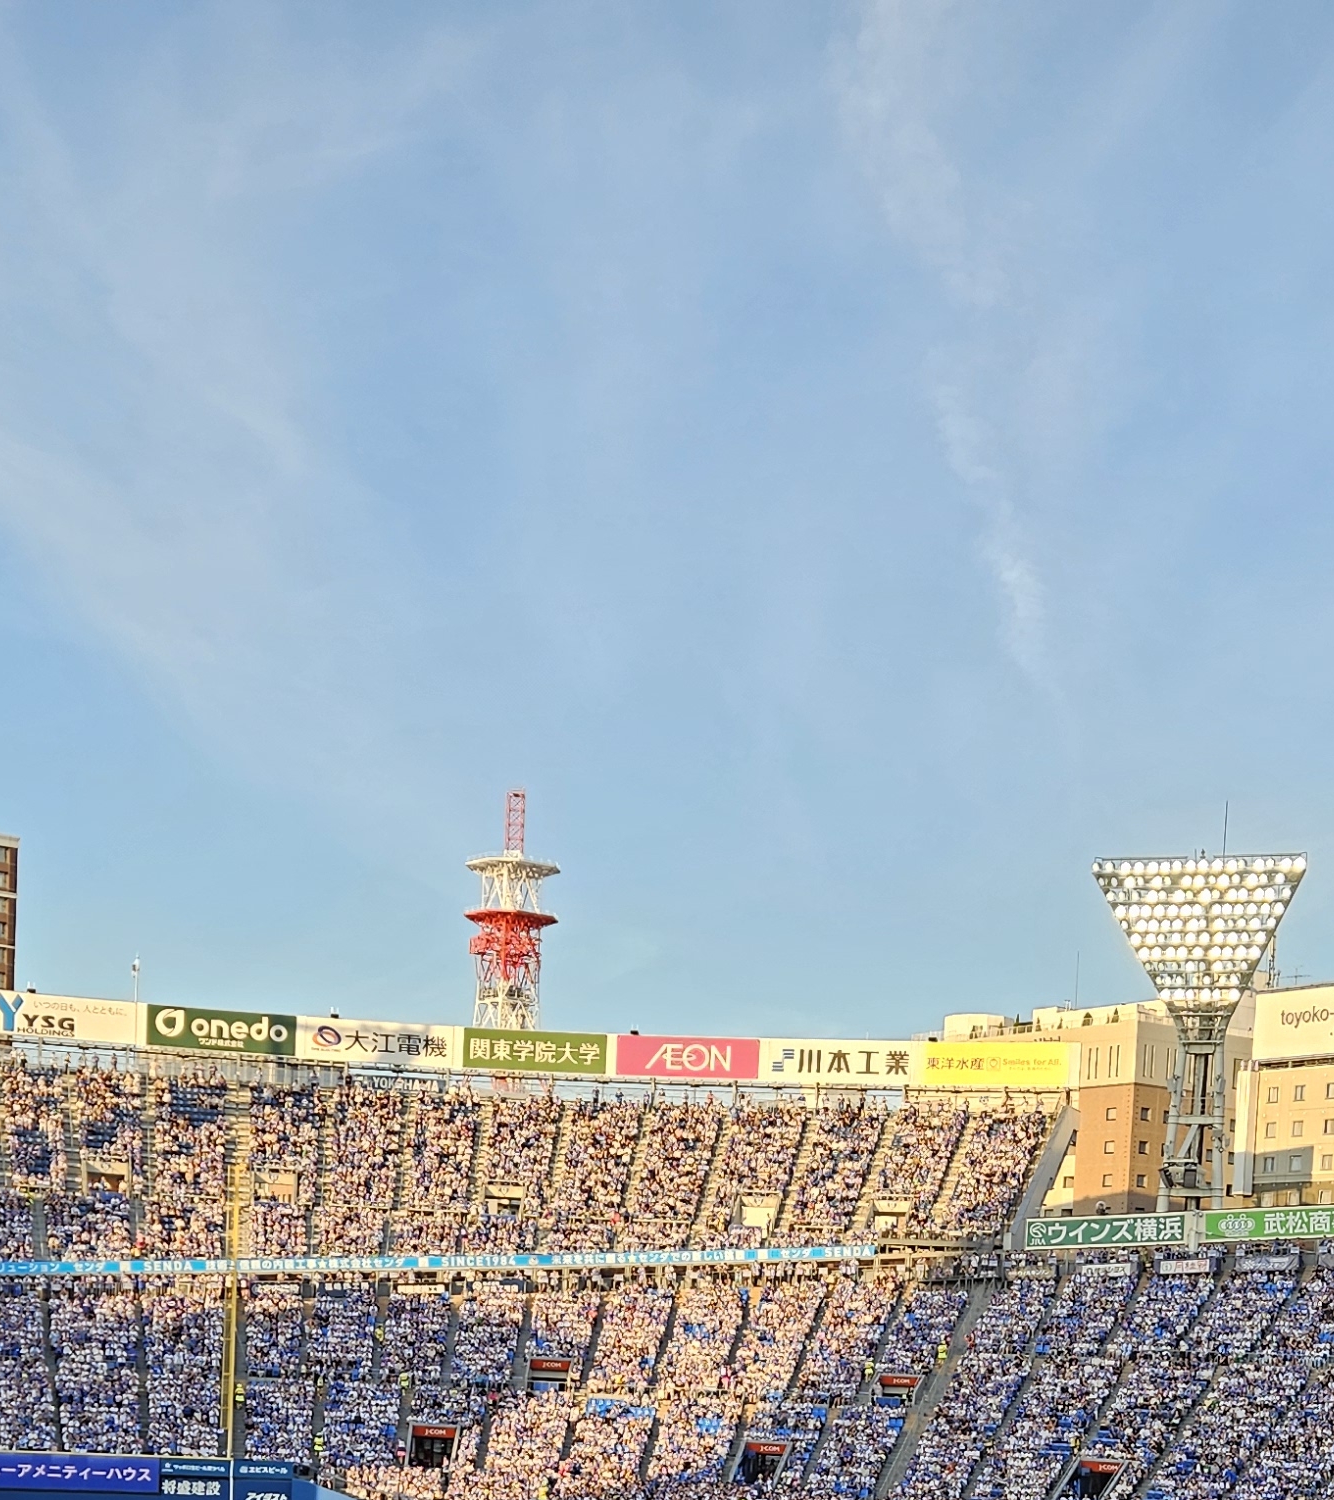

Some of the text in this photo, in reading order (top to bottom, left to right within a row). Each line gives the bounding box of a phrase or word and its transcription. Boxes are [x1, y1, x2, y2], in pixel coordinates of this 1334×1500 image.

[33, 1001, 128, 1016] いつの日も、人とともに。
[22, 1014, 75, 1032] YSG
[191, 1017, 288, 1041] onedo
[17, 1027, 75, 1037] HOLDINGS
[345, 1030, 447, 1057] 大江電機
[470, 1038, 600, 1064] 関東学院大学
[799, 1050, 909, 1075] 川本工業
[927, 1056, 983, 1070] 東洋水産
[1047, 1218, 1182, 1242] ウインズ横浜
[1029, 1238, 1045, 1246] JRA
[824, 1246, 873, 1257] SENDA
[74, 1263, 104, 1271] センダ
[144, 1261, 192, 1271] SENDA
